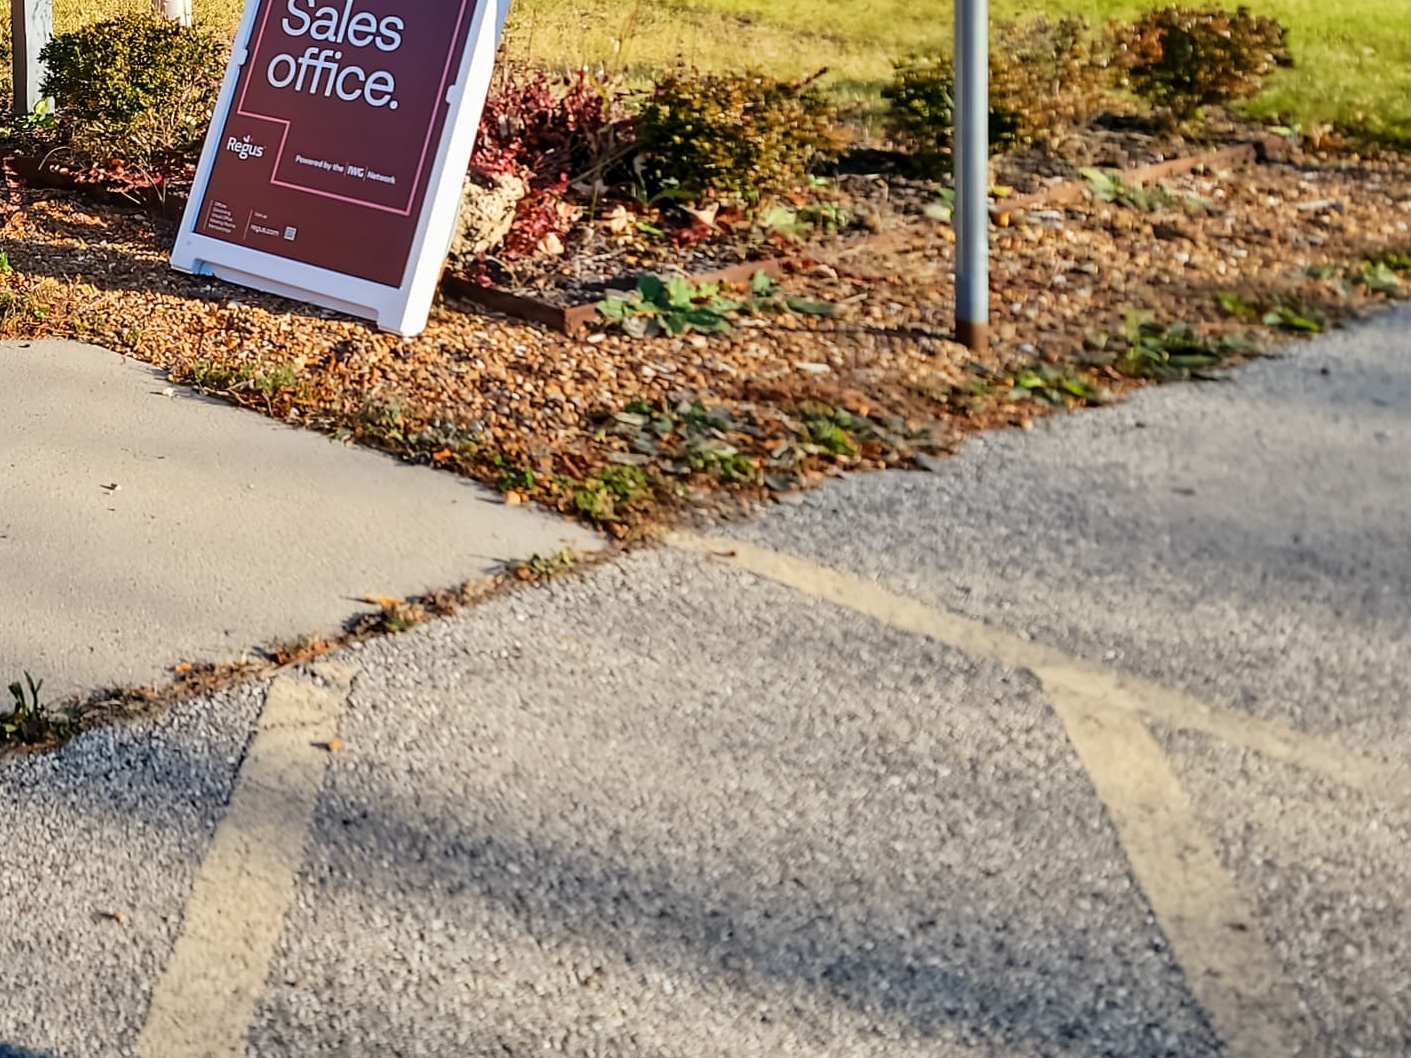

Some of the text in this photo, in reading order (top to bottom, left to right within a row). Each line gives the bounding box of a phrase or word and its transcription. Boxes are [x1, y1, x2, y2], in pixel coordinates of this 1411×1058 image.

[267, 47, 398, 110] office.
[226, 134, 264, 160] Regus
[295, 154, 396, 184] Powered by the IWG Network
